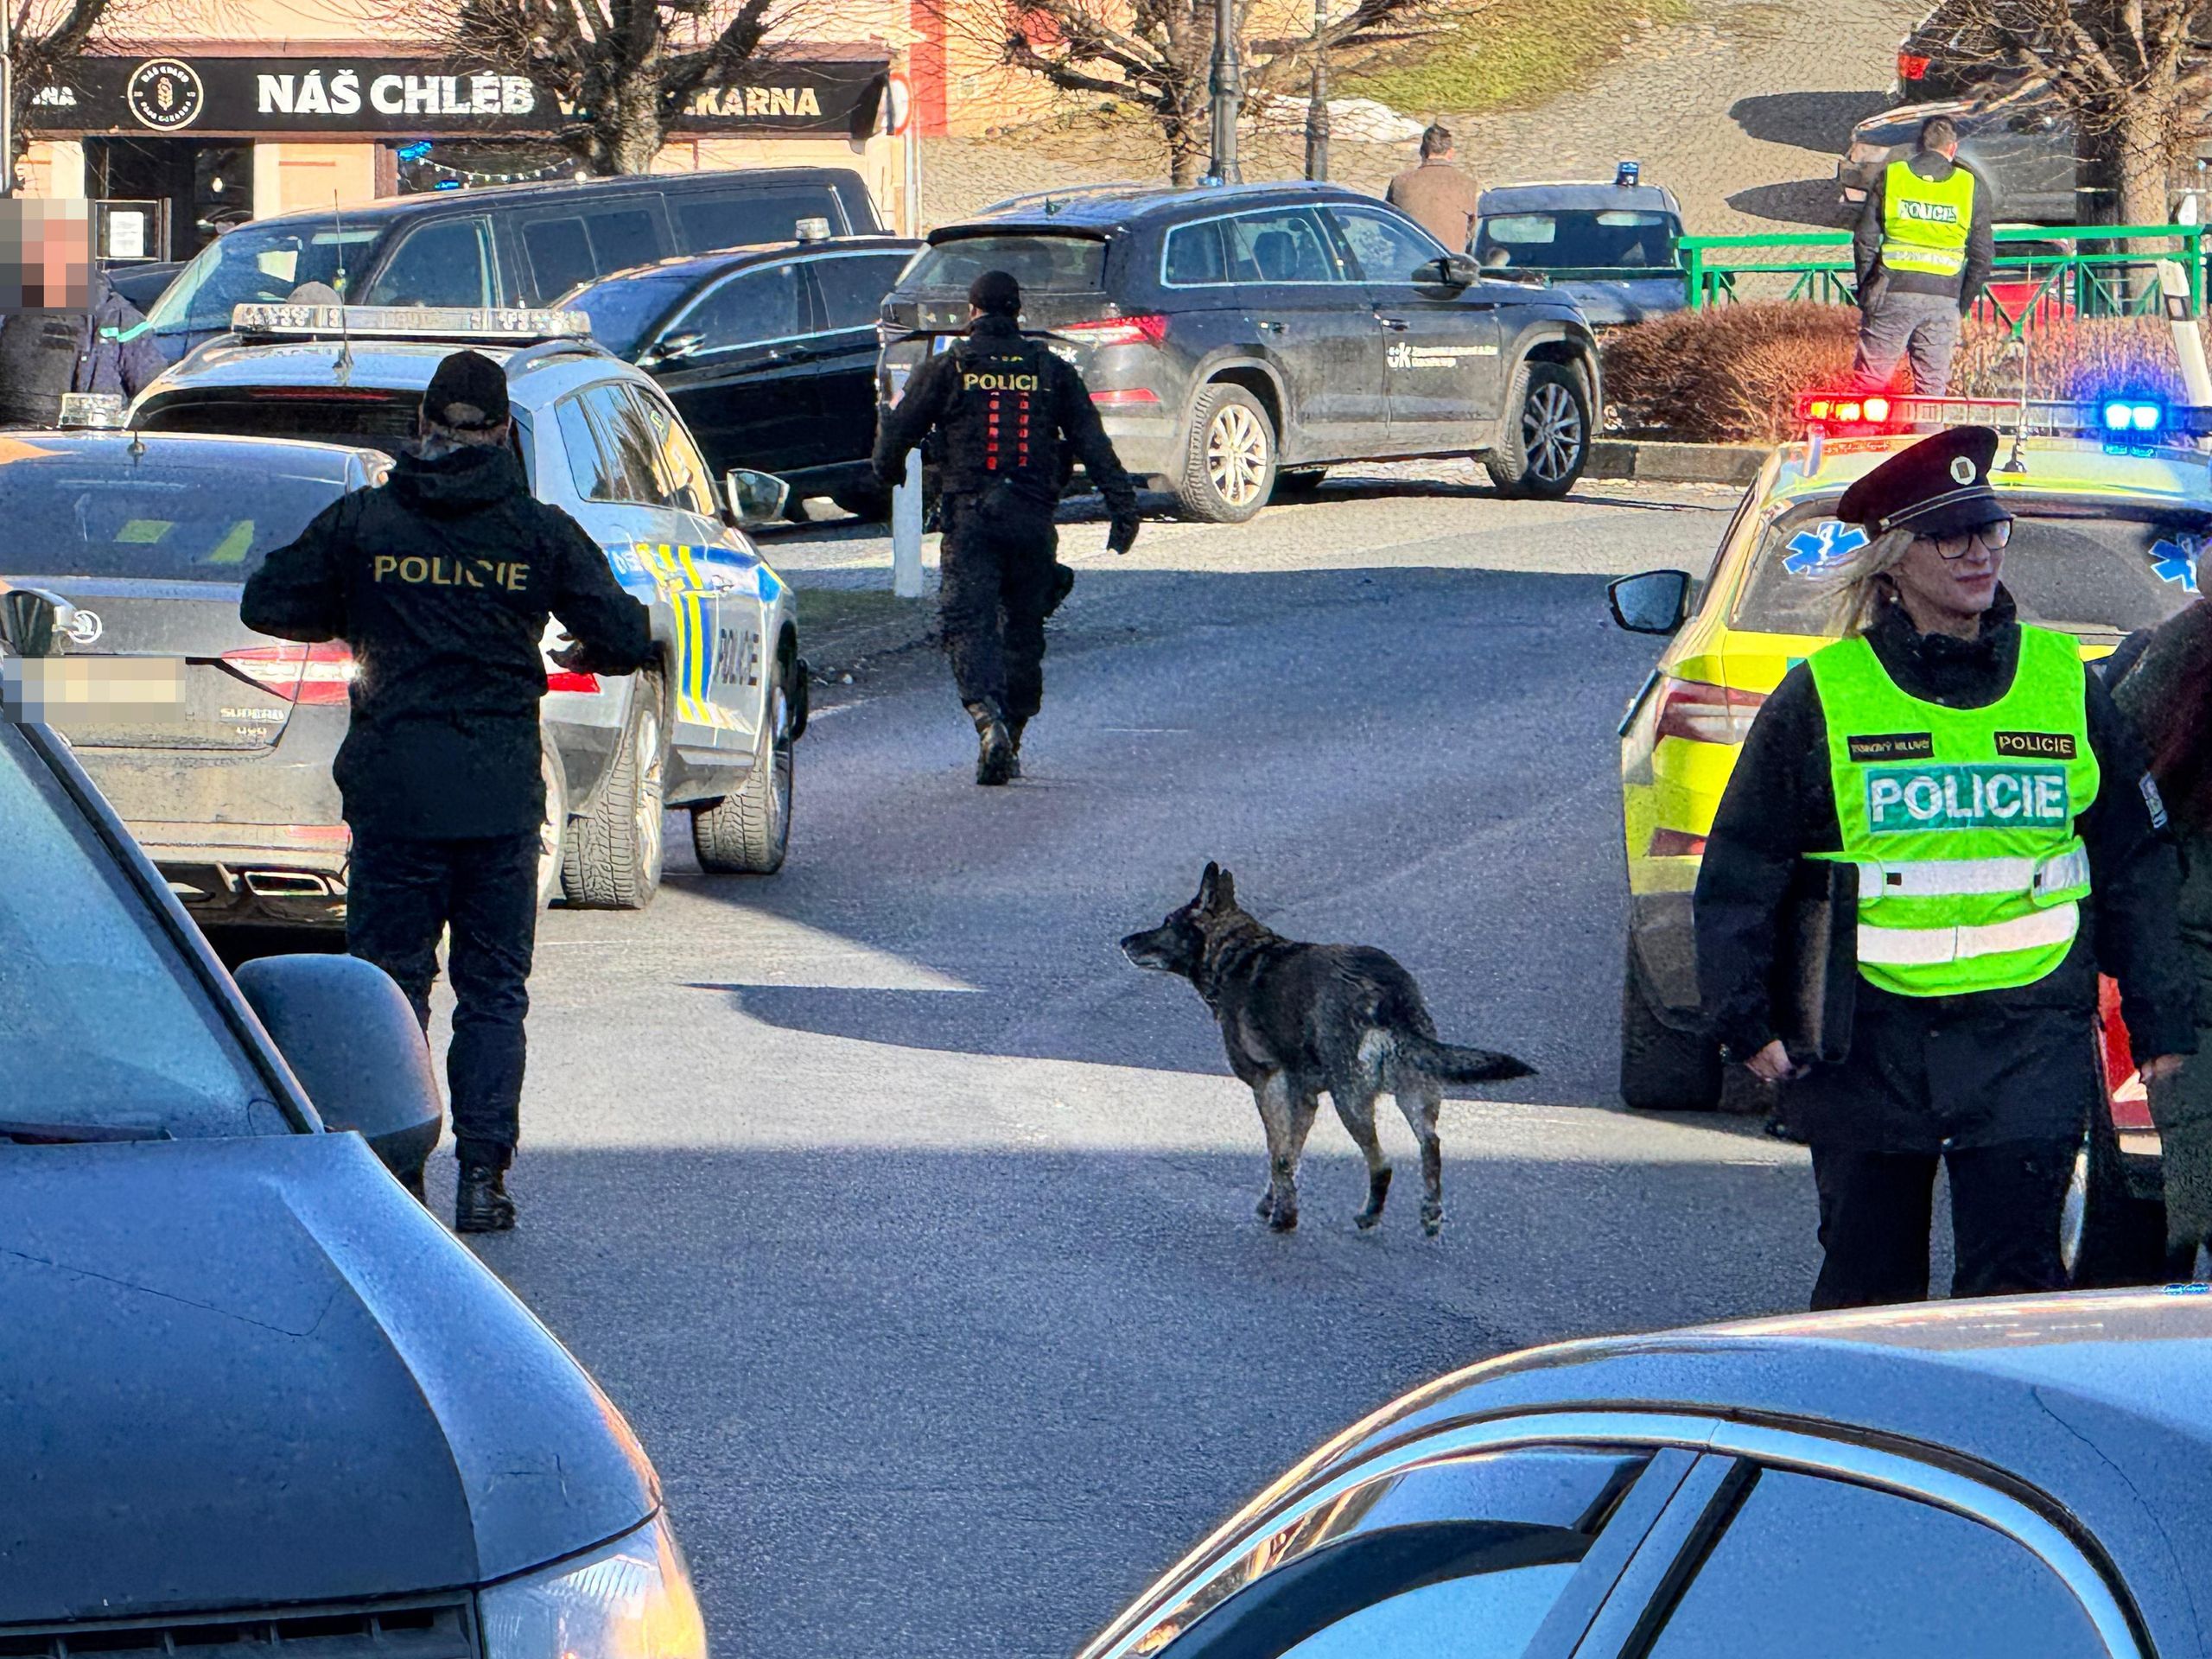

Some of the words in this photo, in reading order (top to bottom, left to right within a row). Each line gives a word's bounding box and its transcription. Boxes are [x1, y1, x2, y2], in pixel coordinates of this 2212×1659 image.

[257, 69, 361, 114] NÁŠ
[370, 70, 535, 114] CHLÉB
[963, 372, 1051, 391] POLICI
[374, 555, 531, 591] POLICIE
[1998, 734, 2073, 754] POLICIE
[1871, 773, 2064, 822] POLICIE
